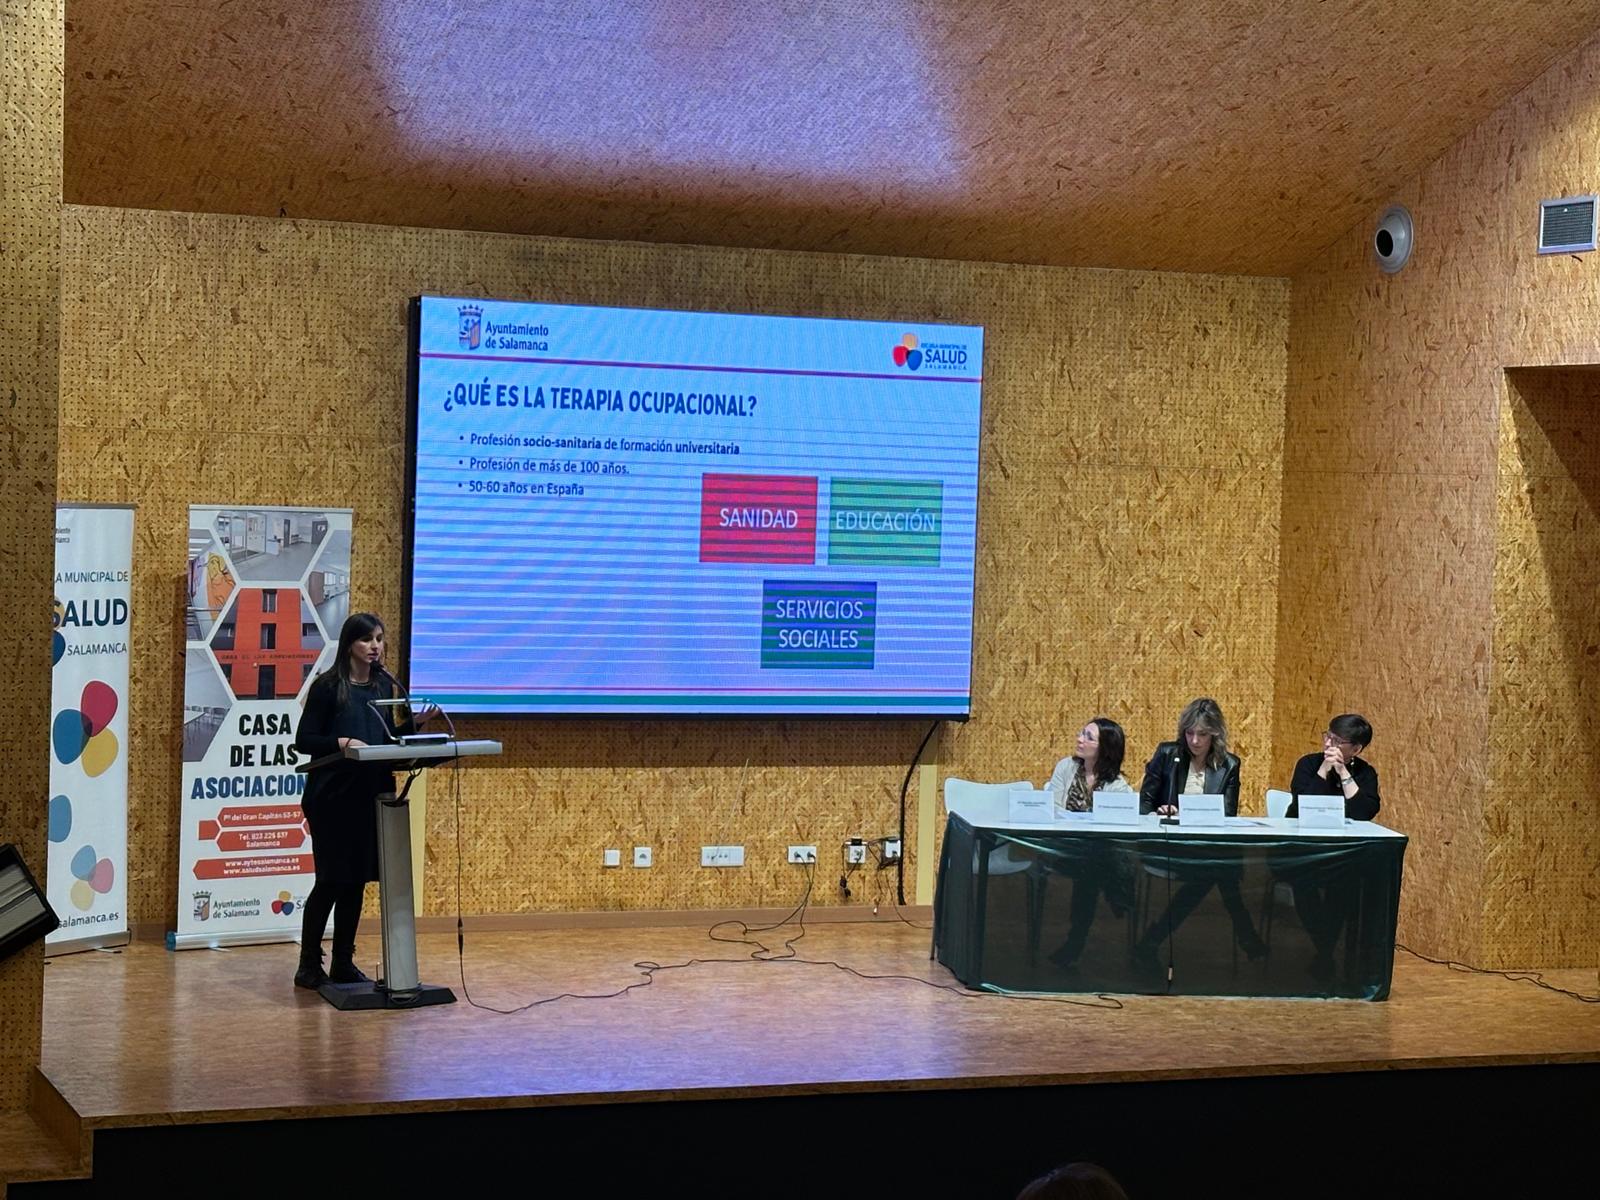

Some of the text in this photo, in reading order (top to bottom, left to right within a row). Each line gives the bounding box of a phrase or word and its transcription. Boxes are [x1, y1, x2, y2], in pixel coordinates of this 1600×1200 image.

[485, 321, 549, 338] Ayuntamiento
[485, 337, 548, 351] de Salamanca
[925, 349, 967, 364] SALUD
[444, 377, 757, 417] ¿QUÉ ES LA TERAPIA OCUPACIONAL?
[470, 433, 740, 455] Profesión socio-sanitaria de formación universitaria
[469, 457, 630, 475] Profesión de más de 100 años.
[469, 480, 584, 498] 50-60 años en España
[719, 508, 798, 530] SANIDAD
[835, 508, 936, 532] EDUCACIÓN
[65, 571, 115, 583] MUNICIPAL
[117, 571, 128, 582] DE
[53, 598, 128, 628] SALUD
[775, 600, 863, 620] SERVICIOS
[779, 629, 859, 649] SOCIALES
[67, 643, 127, 656] SALAMANCA
[238, 713, 292, 736] CASA
[230, 743, 299, 767] DE LAS
[191, 774, 309, 799] ASOCIACION
[213, 898, 260, 910] Ayuntamiento
[213, 908, 260, 918] de Salamanca
[59, 912, 119, 928] salamanca.es
